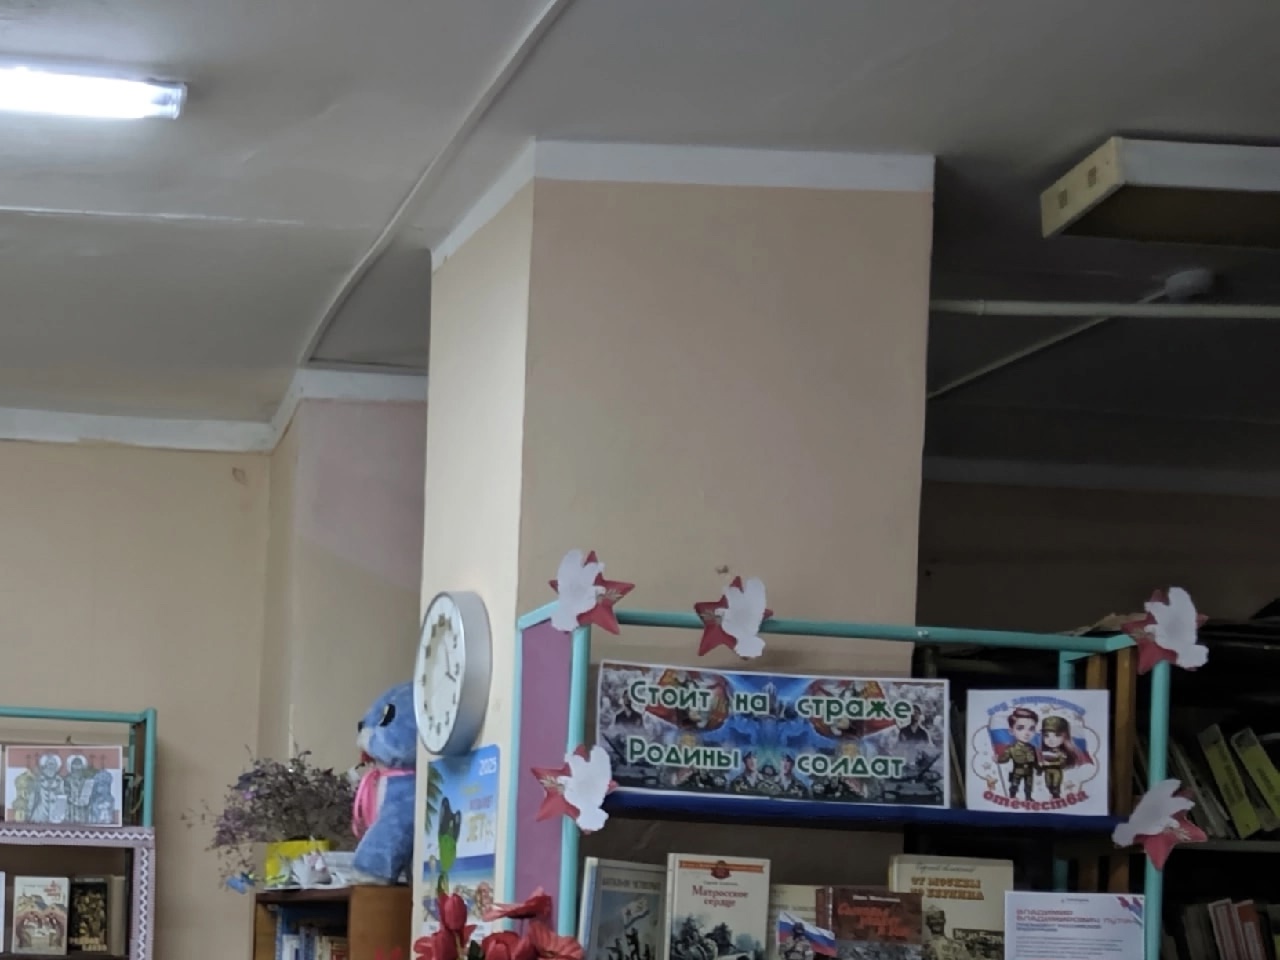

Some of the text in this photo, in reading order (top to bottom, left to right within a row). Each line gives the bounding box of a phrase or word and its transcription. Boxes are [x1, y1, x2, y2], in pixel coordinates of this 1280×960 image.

[629, 680, 912, 721] Стоит на страже
[629, 737, 905, 778] Родины солдат
[983, 790, 1090, 811] отечества
